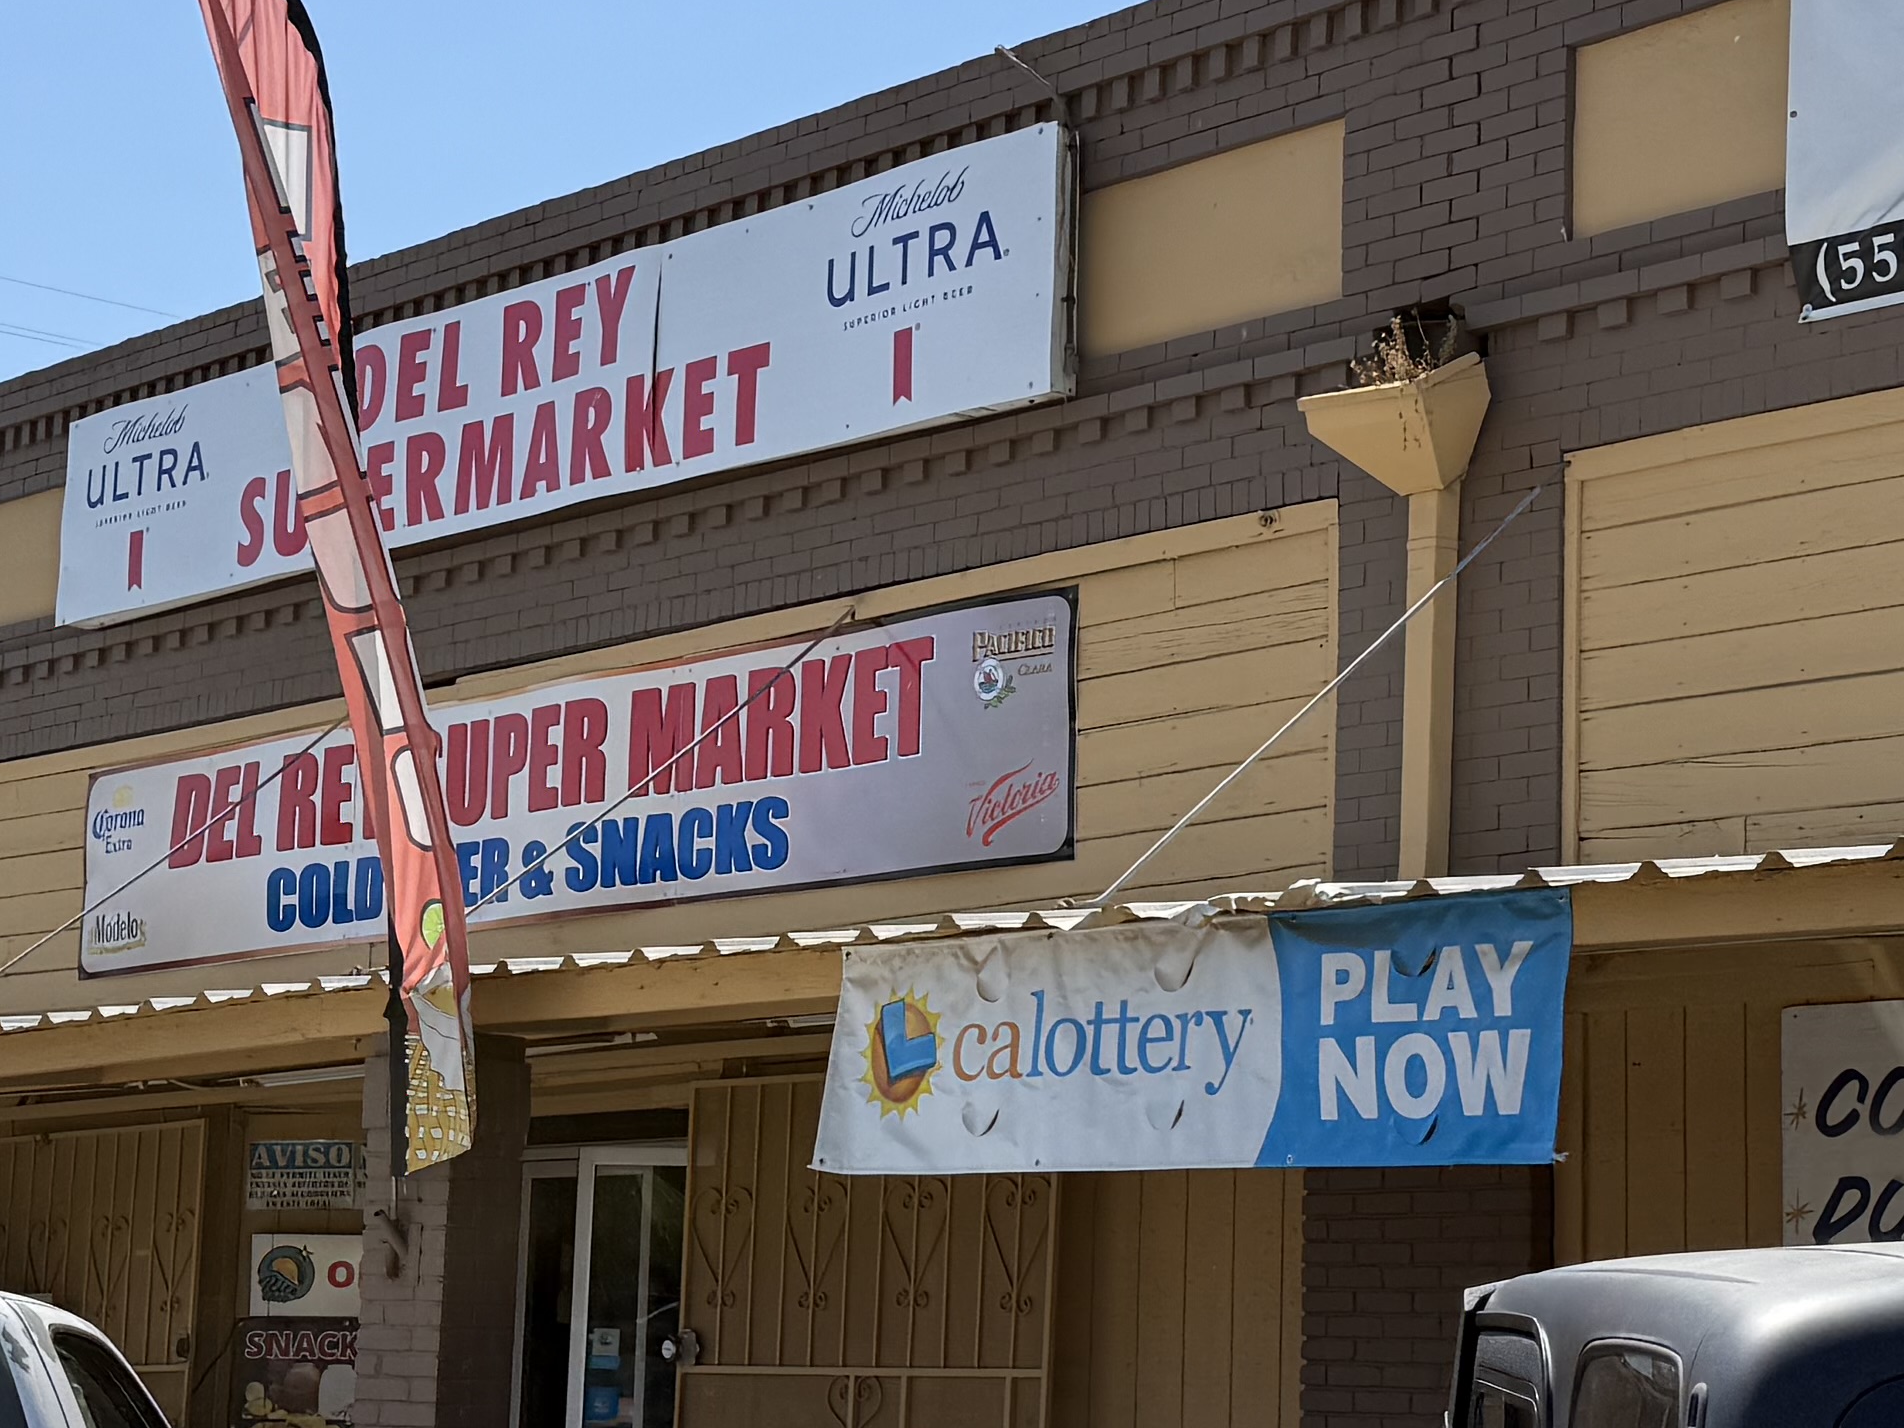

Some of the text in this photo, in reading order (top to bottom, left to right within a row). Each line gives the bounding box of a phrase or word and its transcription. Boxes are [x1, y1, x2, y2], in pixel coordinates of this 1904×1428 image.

[851, 164, 970, 239] Michelob
[827, 209, 1003, 308] ULTRA
[355, 264, 636, 432] DEL REY
[843, 285, 974, 332] SUPERIOR LIGHT BEER
[104, 403, 189, 454] Michelob
[236, 341, 771, 568] SUERMARKET
[86, 440, 207, 509] ULTRA
[168, 635, 935, 870] DEL RE UPER MARKET
[92, 808, 145, 840] Corona
[105, 835, 132, 854] Extra
[965, 758, 1060, 847] Victoria
[266, 796, 790, 933] COLD ER & SNACKS
[96, 911, 139, 944] Modelo
[1319, 940, 1534, 1026] PLAY
[952, 989, 1254, 1096] calottery
[1318, 1029, 1532, 1121] NOW
[251, 1144, 351, 1168] AVISO
